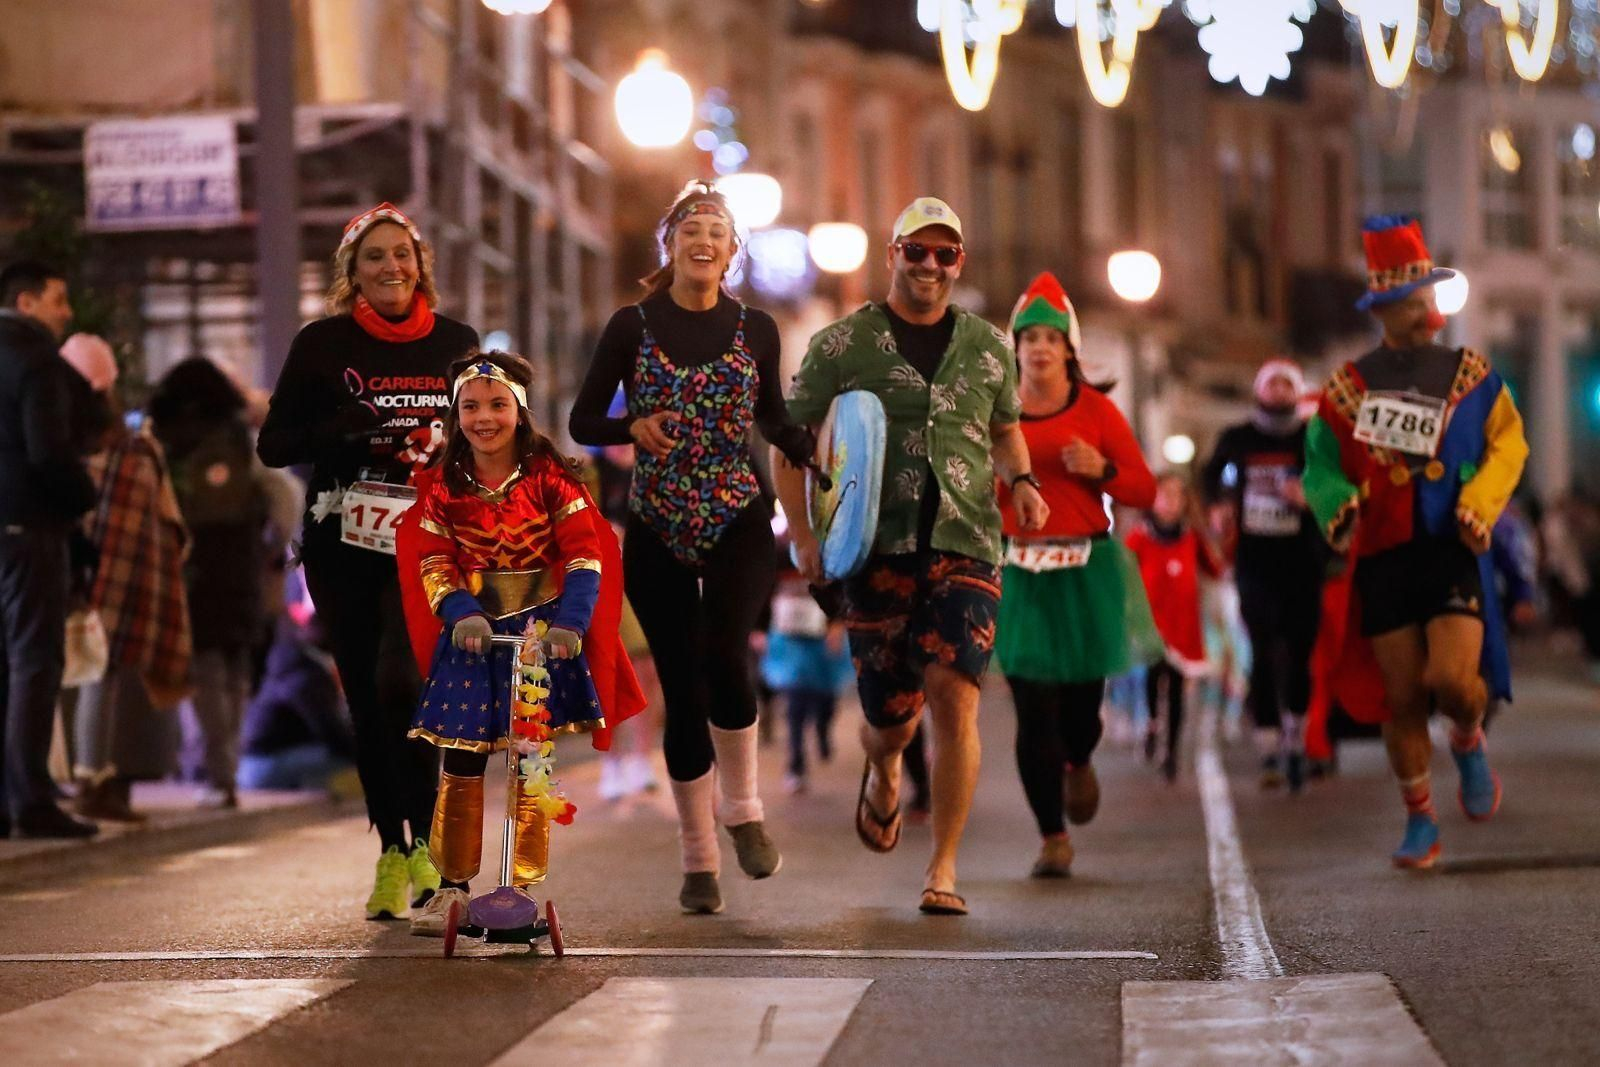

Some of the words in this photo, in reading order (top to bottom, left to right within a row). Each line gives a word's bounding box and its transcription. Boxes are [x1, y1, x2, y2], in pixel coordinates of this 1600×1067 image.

[368, 376, 447, 391] CARRERA
[373, 394, 451, 408] NOCTURNA
[397, 408, 436, 417] SFRACES
[381, 417, 420, 428] ANADA
[1366, 404, 1436, 436] 1786
[350, 503, 405, 531] 174
